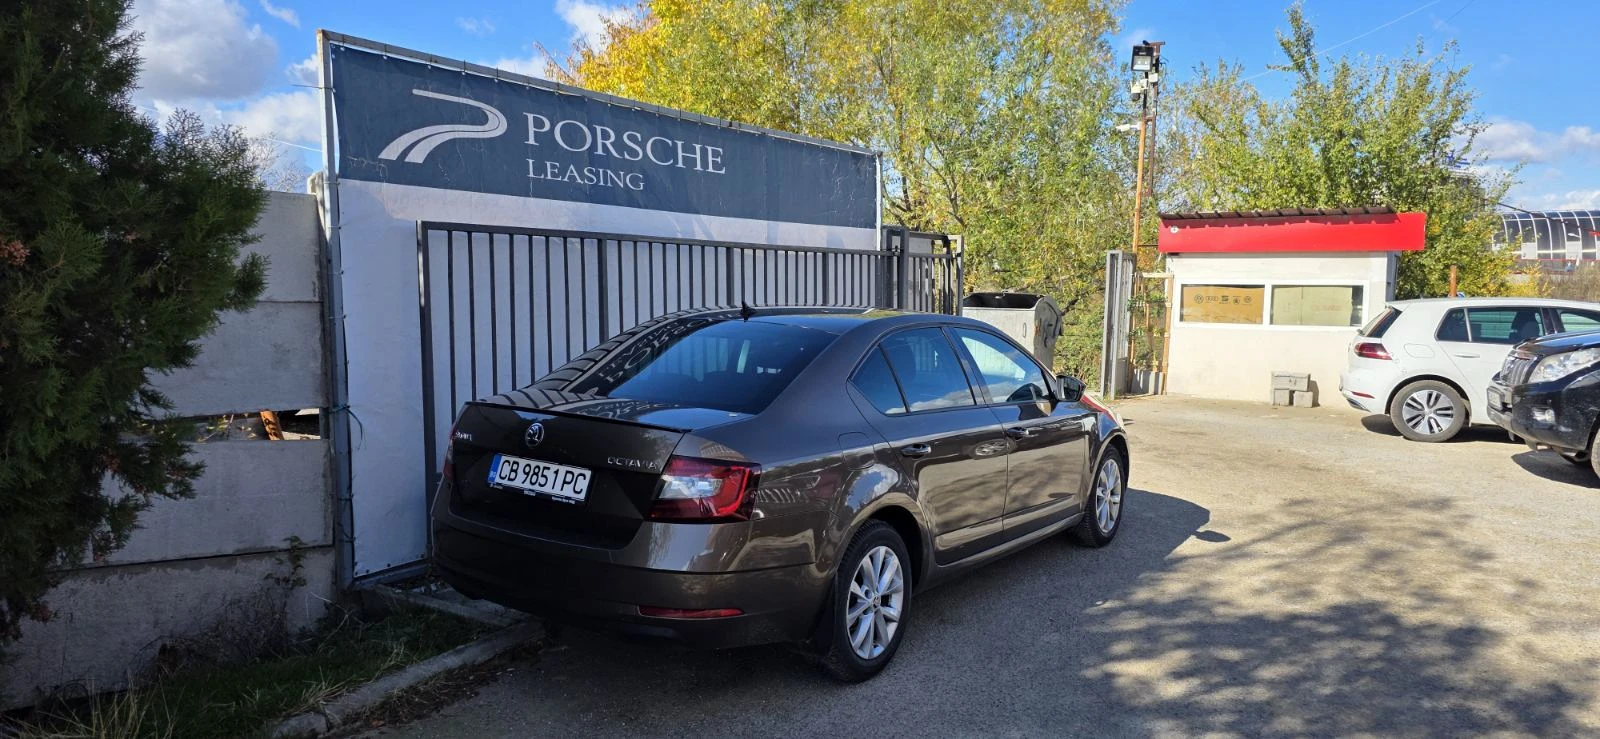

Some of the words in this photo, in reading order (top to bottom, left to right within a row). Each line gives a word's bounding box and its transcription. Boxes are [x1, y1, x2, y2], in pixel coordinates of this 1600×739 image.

[523, 112, 725, 174] PORSCHE
[527, 159, 645, 190] LEASING
[499, 460, 519, 481] CB
[522, 463, 559, 489] 9851
[561, 470, 586, 494] PC
[607, 456, 657, 469] OCTAVIA
